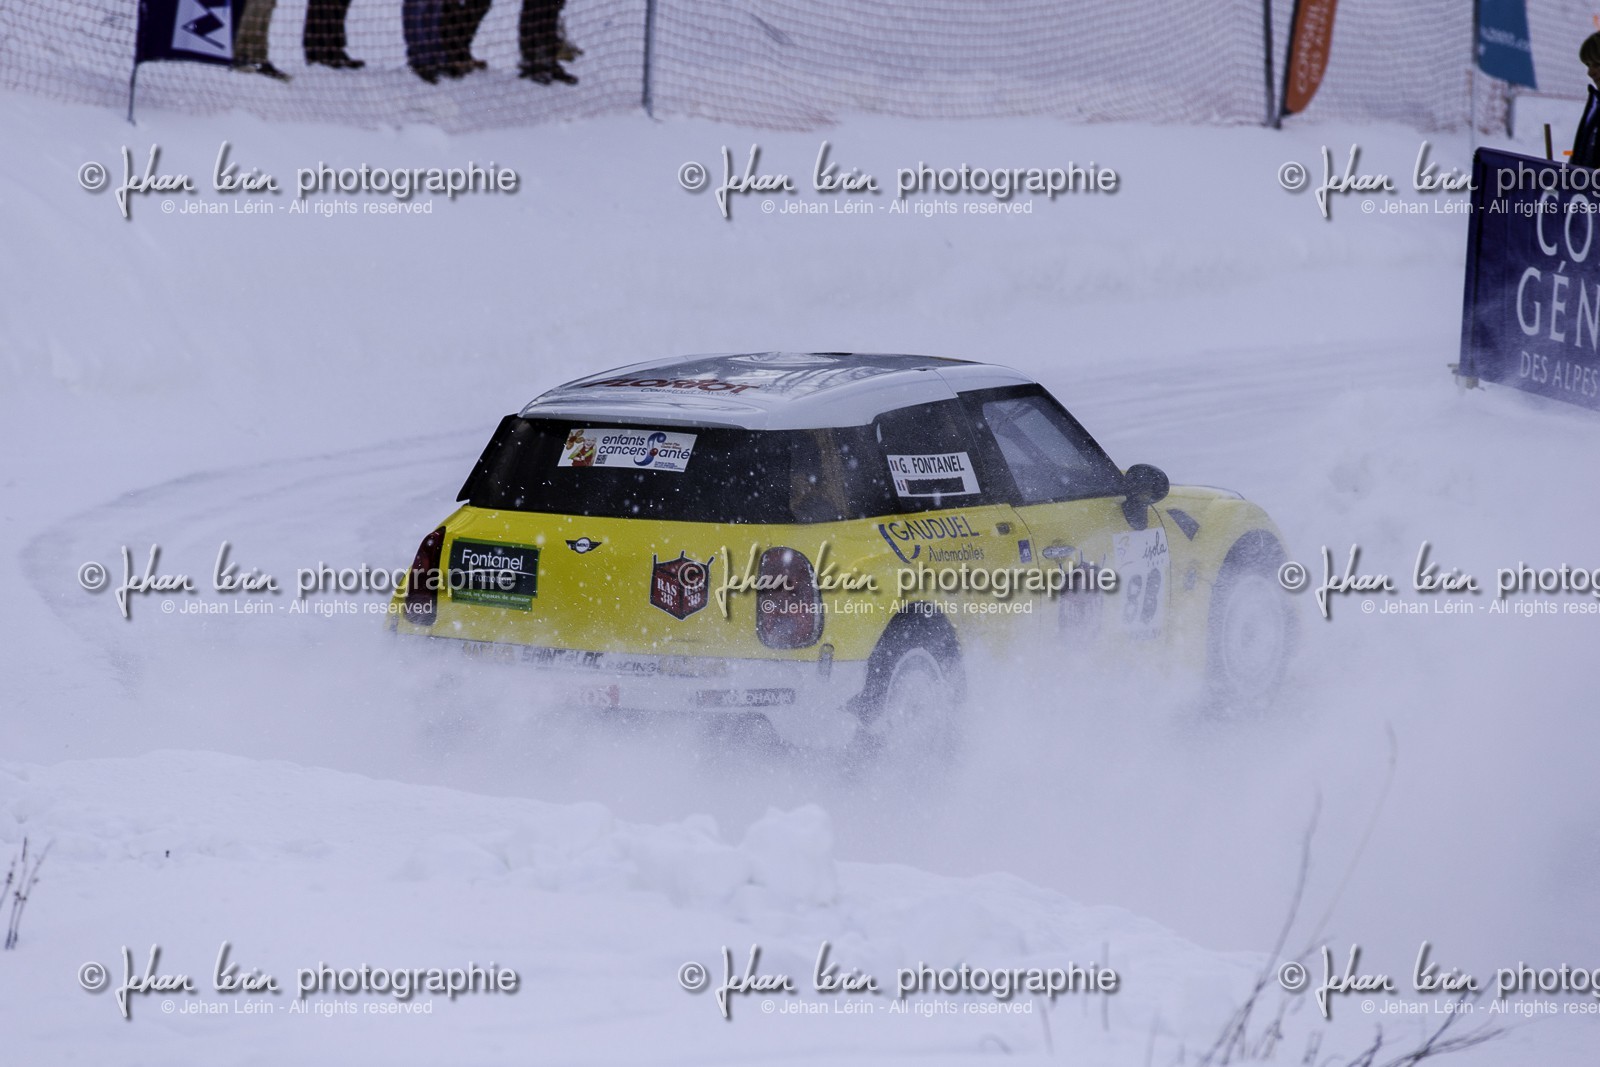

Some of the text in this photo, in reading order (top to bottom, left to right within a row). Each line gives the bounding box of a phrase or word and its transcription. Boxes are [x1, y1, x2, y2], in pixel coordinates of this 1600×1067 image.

[1537, 186, 1595, 263] CO
[1520, 350, 1548, 384] DES
[602, 434, 646, 446] enfants
[598, 445, 647, 457] cancers
[900, 455, 965, 474] G. FONTANEL
[889, 516, 980, 541] GAUDUEL
[461, 549, 523, 571] Fontanel
[928, 543, 985, 562] Automobiles
[657, 577, 677, 597] RAS
[660, 591, 673, 606] 38
[687, 592, 701, 607] 38
[721, 691, 793, 705] YOOHAMA
